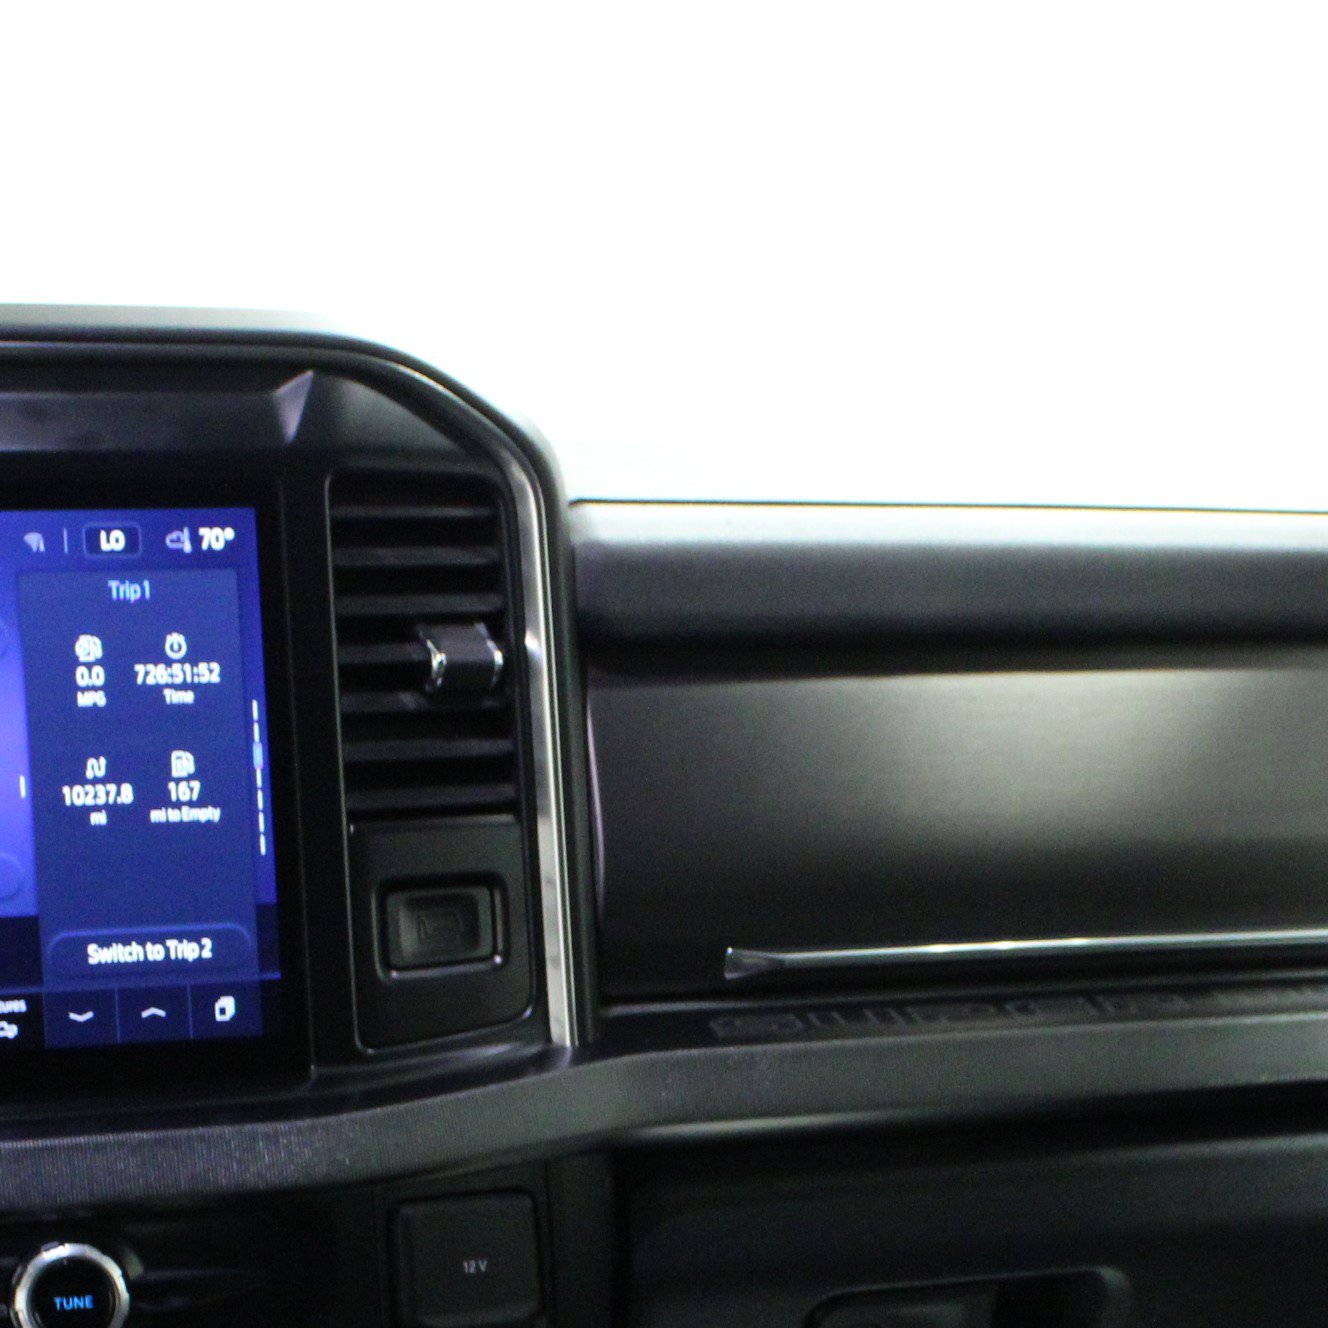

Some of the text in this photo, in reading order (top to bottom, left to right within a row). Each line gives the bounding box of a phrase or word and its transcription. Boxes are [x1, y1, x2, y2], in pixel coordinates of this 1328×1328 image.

[100, 530, 125, 551] LO
[76, 665, 105, 687] 0.0
[134, 662, 220, 685] 726:51:52
[77, 690, 106, 707] MPG
[163, 688, 195, 705] Time
[62, 782, 134, 807] 10237.8
[168, 780, 201, 802] 167
[90, 809, 107, 826] mi
[181, 805, 221, 823] Empty
[87, 938, 213, 965] Switch to Trip 2
[53, 1295, 93, 1311] TUNE
